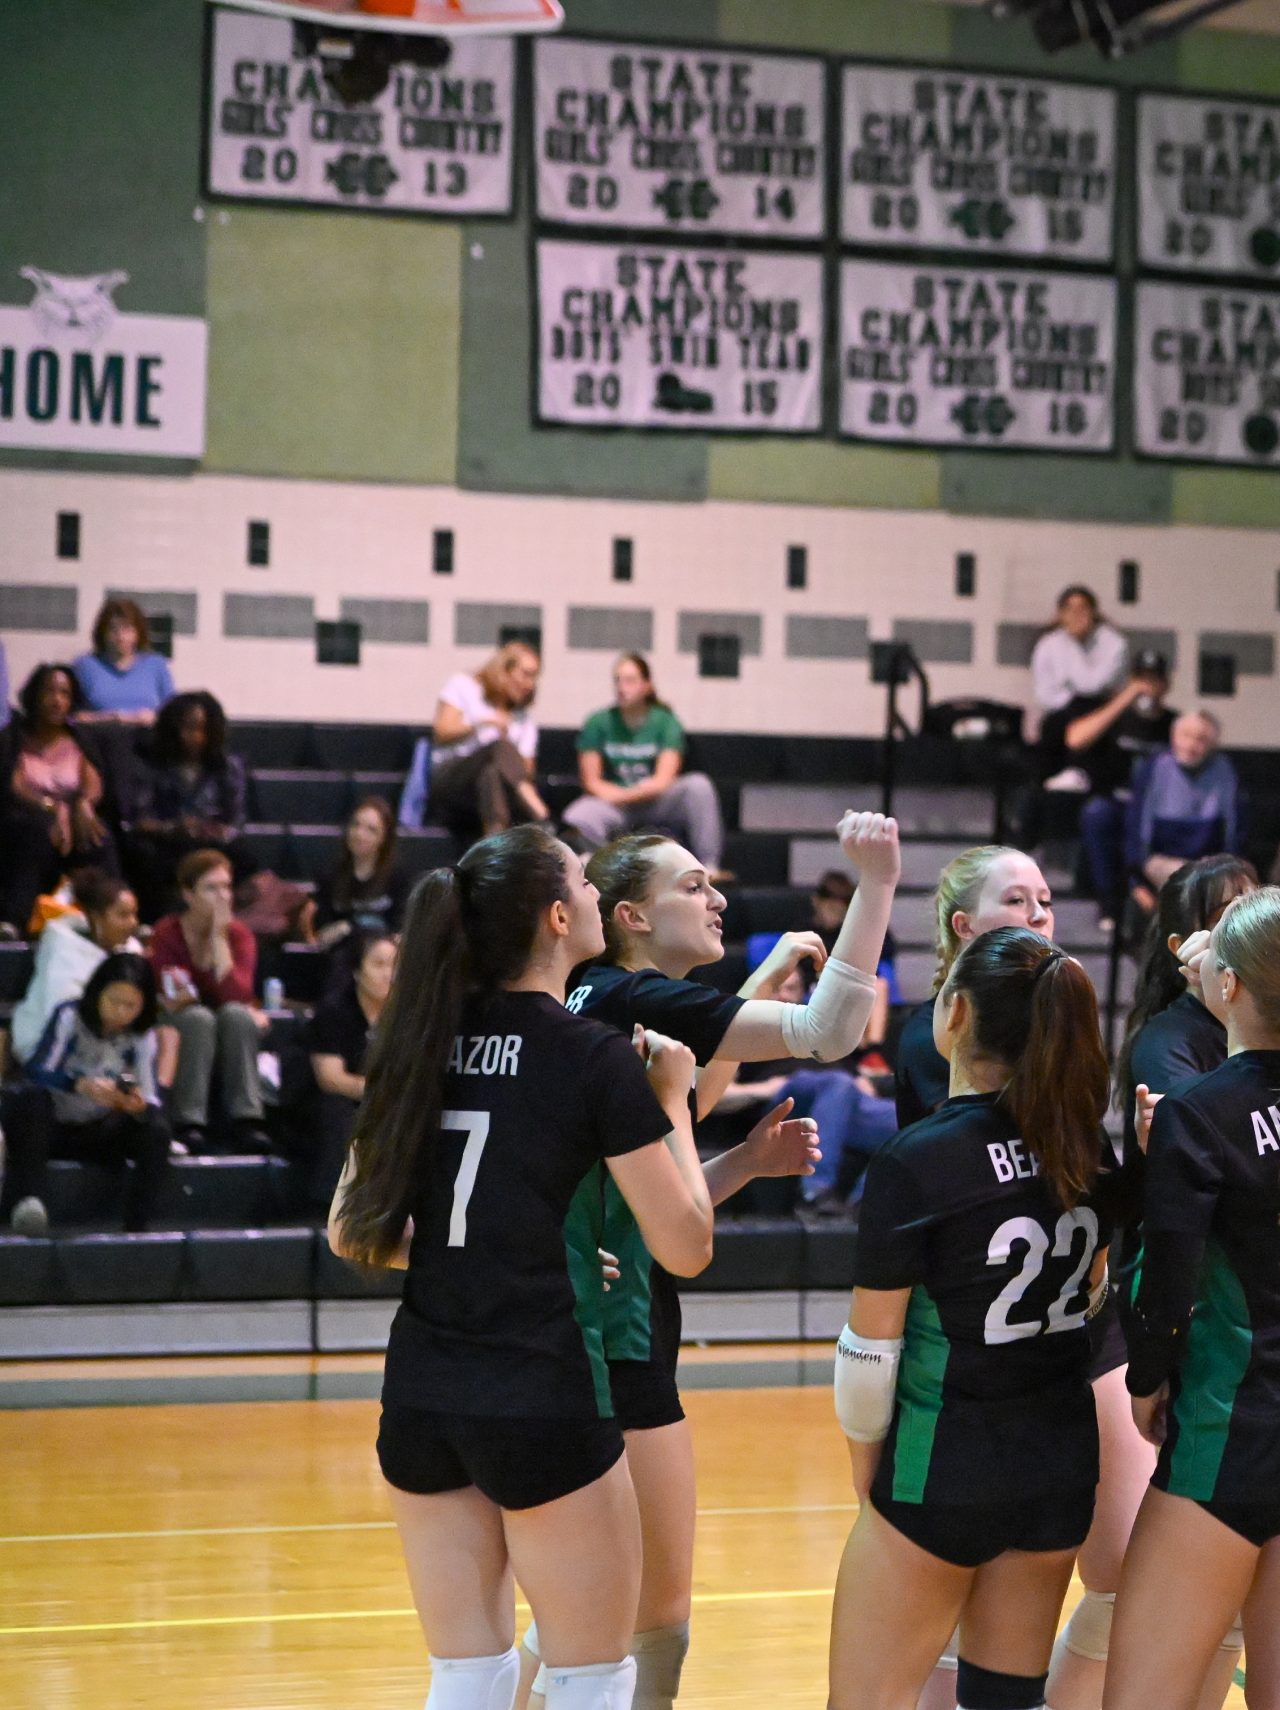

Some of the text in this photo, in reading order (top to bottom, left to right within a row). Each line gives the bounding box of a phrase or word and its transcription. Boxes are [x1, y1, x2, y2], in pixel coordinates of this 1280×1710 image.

[233, 61, 495, 114] CHAIONS
[611, 54, 752, 98] STATE
[557, 87, 806, 137] CHAMPIONS
[915, 80, 1049, 125] STATE
[861, 112, 1097, 162] CHAMPIONS
[241, 144, 297, 183] 20
[424, 160, 467, 196] 13
[567, 173, 618, 209] 20
[756, 184, 796, 221] 14
[617, 255, 746, 297] STATE
[914, 275, 1049, 318] STATE
[563, 286, 799, 334] CHAMPIONS
[861, 308, 1097, 355] CHAMPIONS
[574, 372, 620, 408] 20
[868, 389, 917, 427] 20
[441, 1110, 491, 1248] 7
[984, 1206, 1099, 1345] 22
